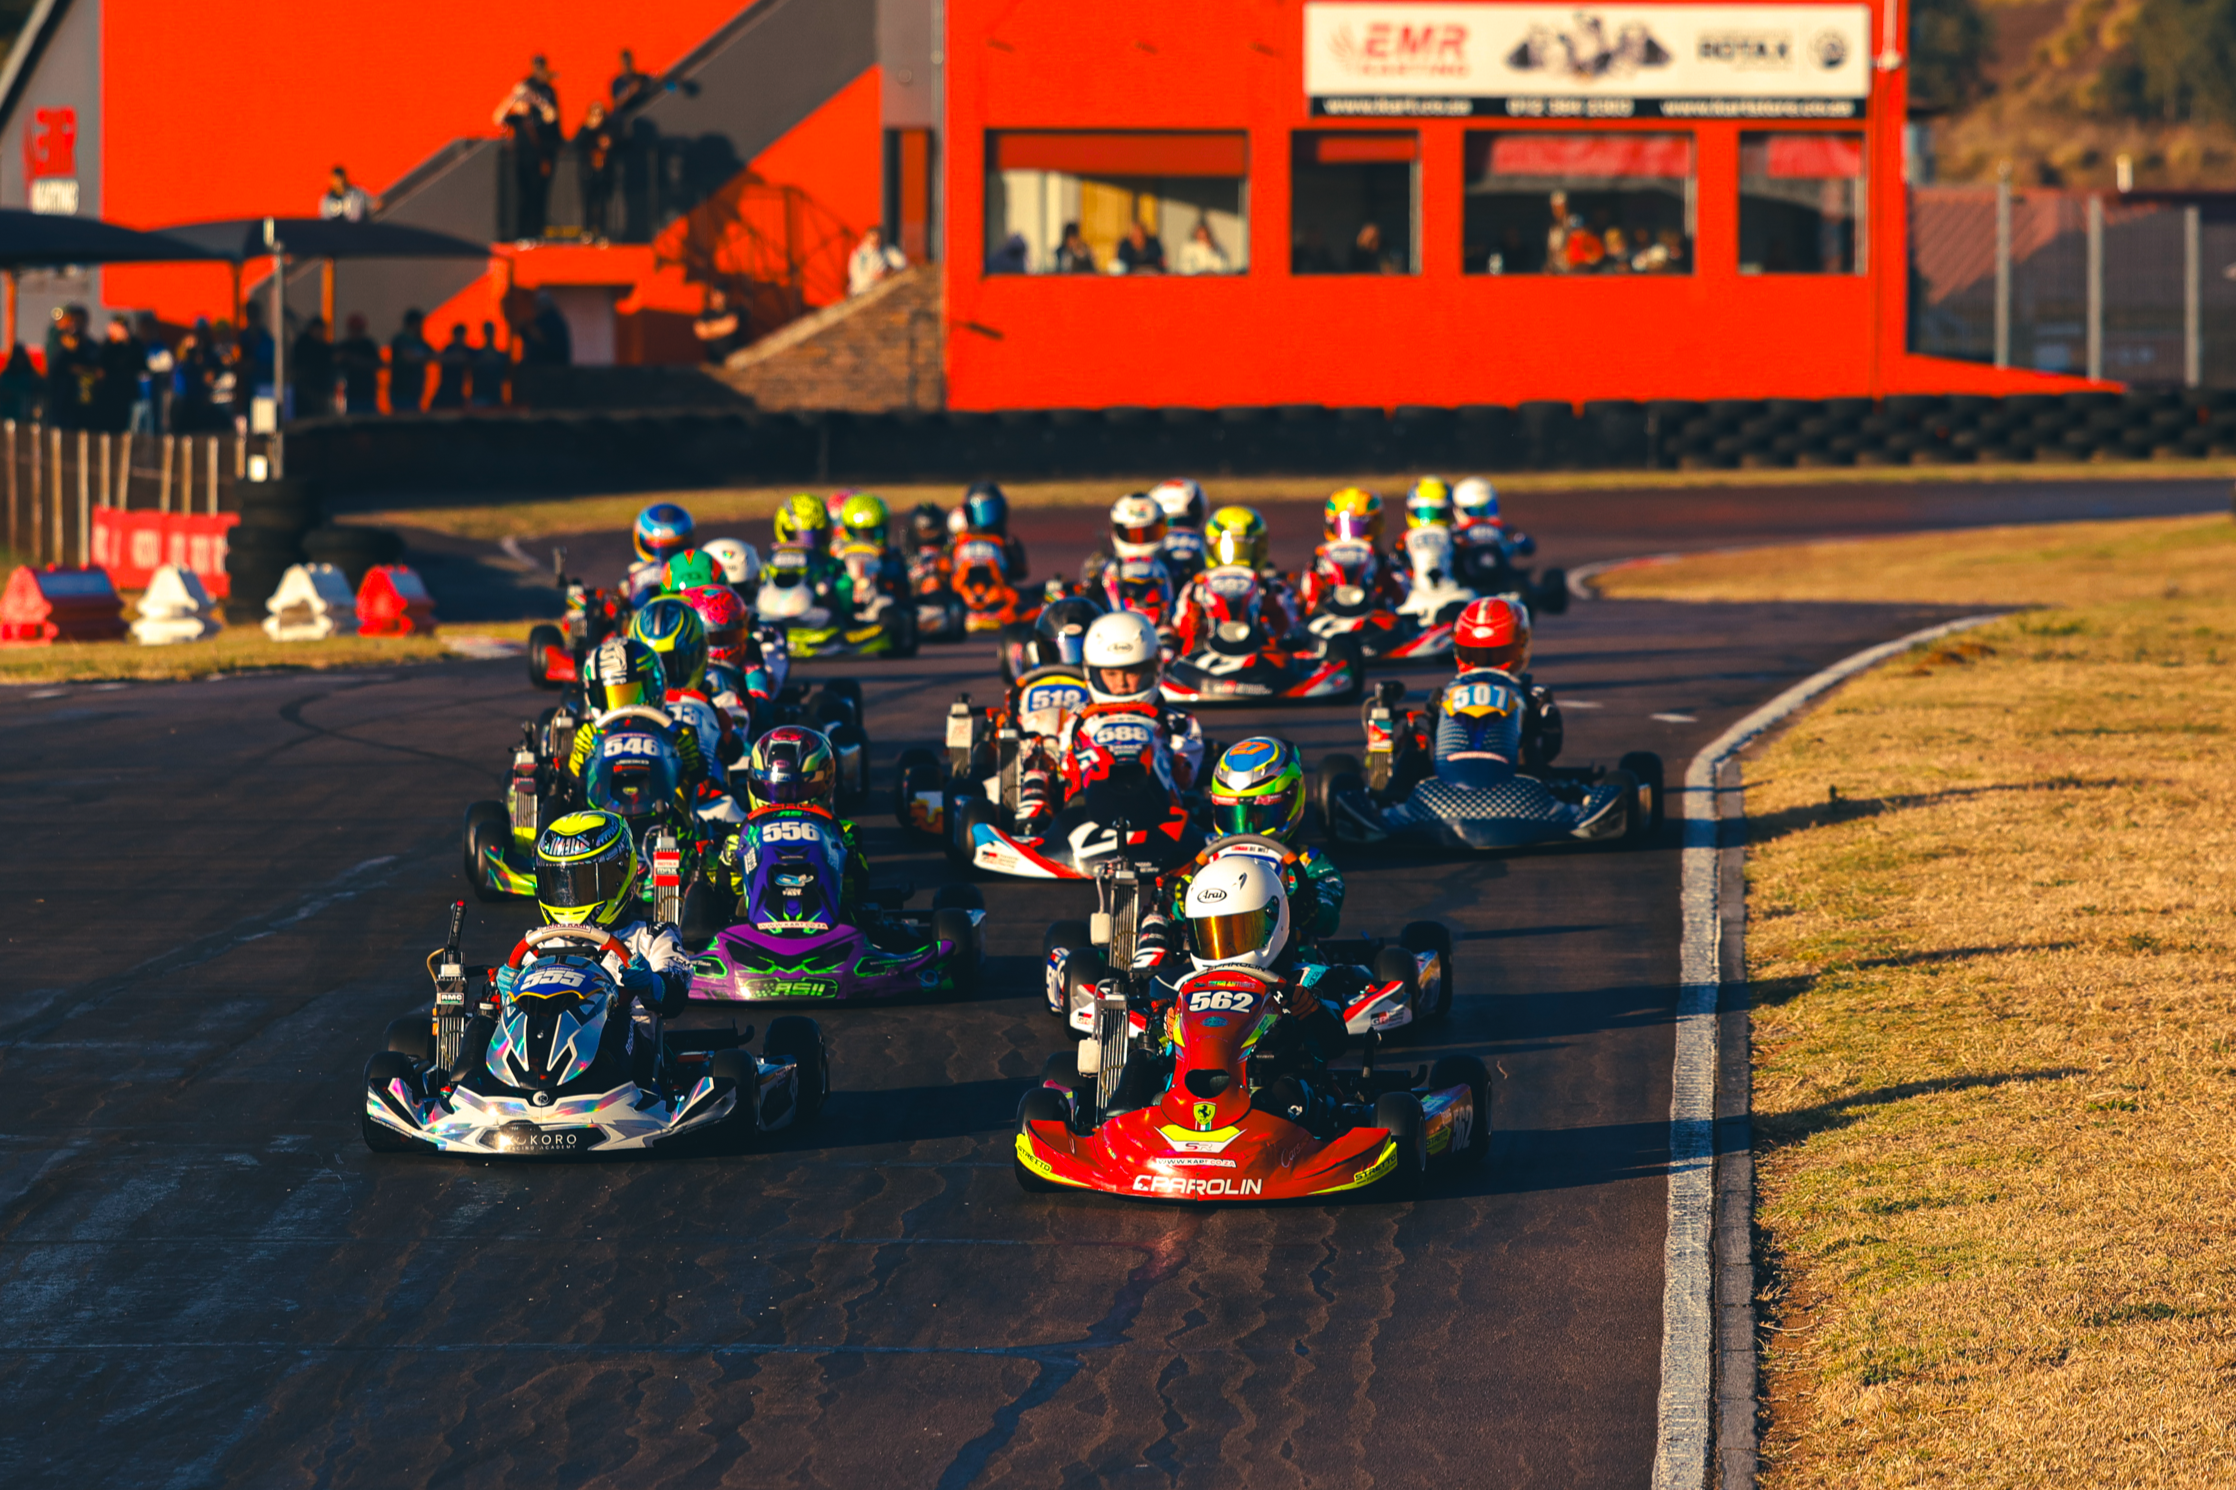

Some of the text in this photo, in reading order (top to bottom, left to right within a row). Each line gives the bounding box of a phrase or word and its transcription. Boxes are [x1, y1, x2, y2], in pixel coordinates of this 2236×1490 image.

[1364, 22, 1468, 57] EMR
[1453, 683, 1508, 709] 507
[604, 737, 660, 757] 546
[1229, 741, 1270, 755] 27
[763, 821, 820, 842] 556
[520, 970, 586, 991] 555
[1189, 991, 1254, 1013] 562
[1017, 1144, 1051, 1172] STRETTO
